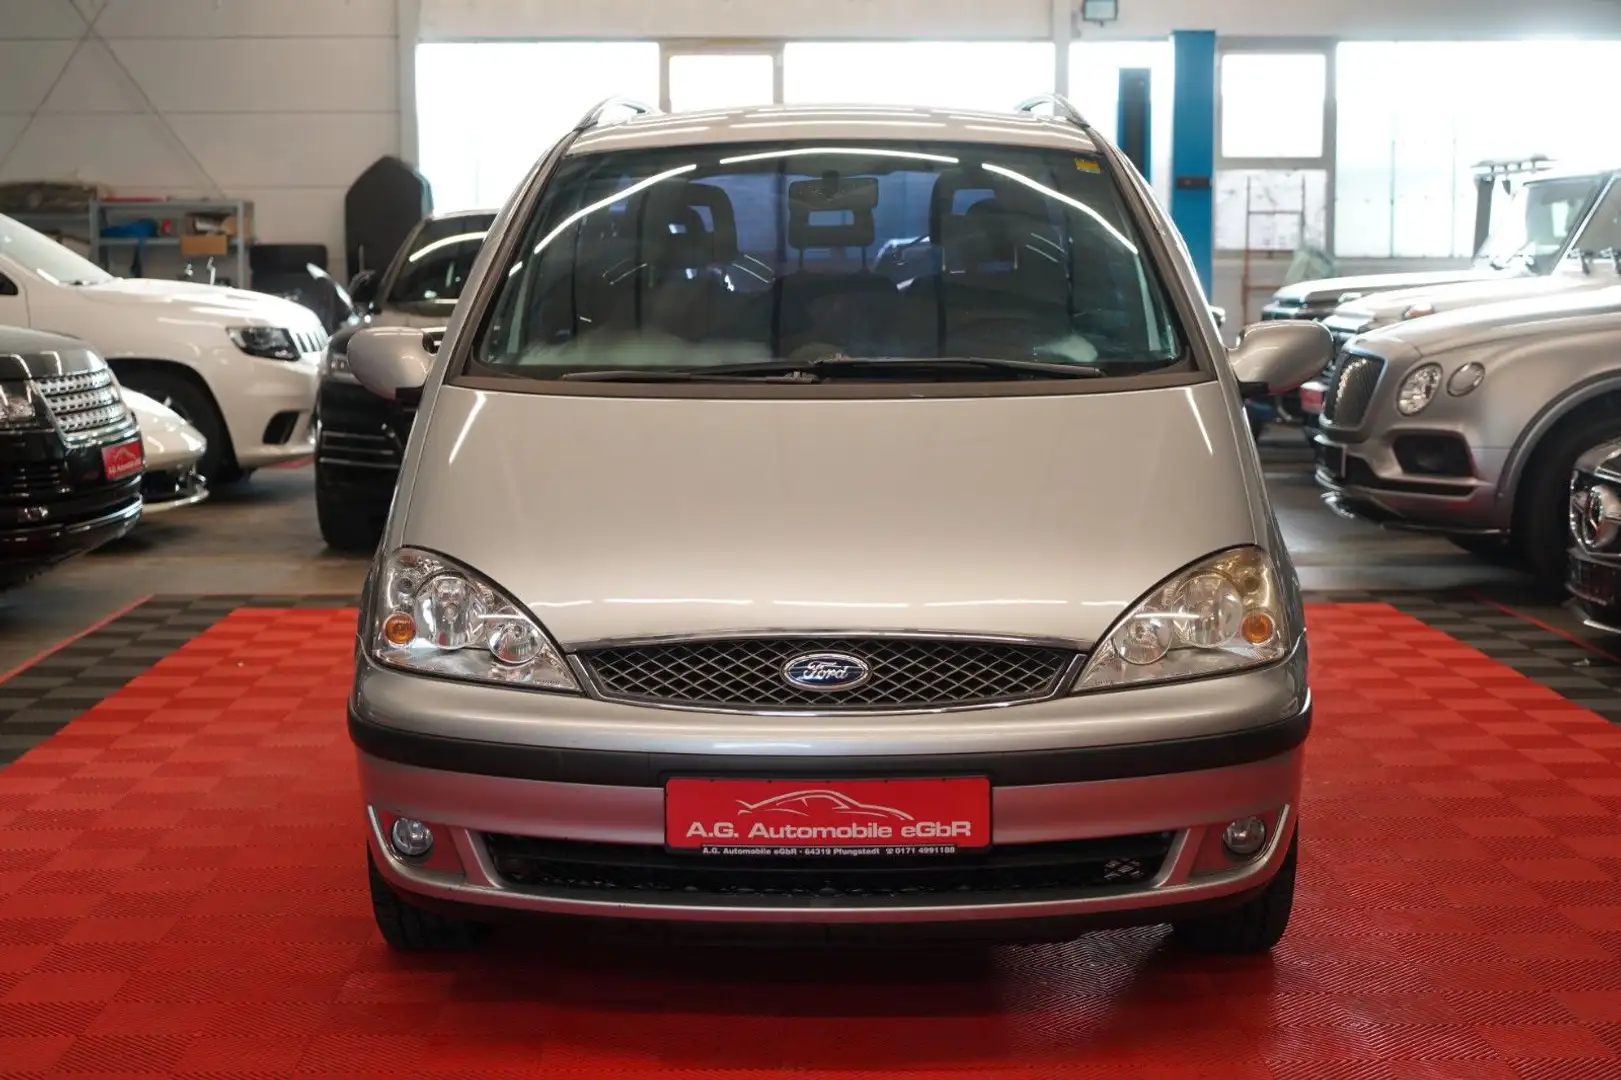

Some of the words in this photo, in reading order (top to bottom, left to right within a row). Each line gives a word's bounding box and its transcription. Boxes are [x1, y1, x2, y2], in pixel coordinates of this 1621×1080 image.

[803, 660, 849, 679] Ford
[686, 821, 739, 838] A.G.
[748, 821, 892, 839] Automobile
[901, 820, 972, 838] eGbR
[702, 847, 721, 855] A.G.
[723, 847, 771, 855] Automobile
[833, 847, 880, 856] Pfungstedt
